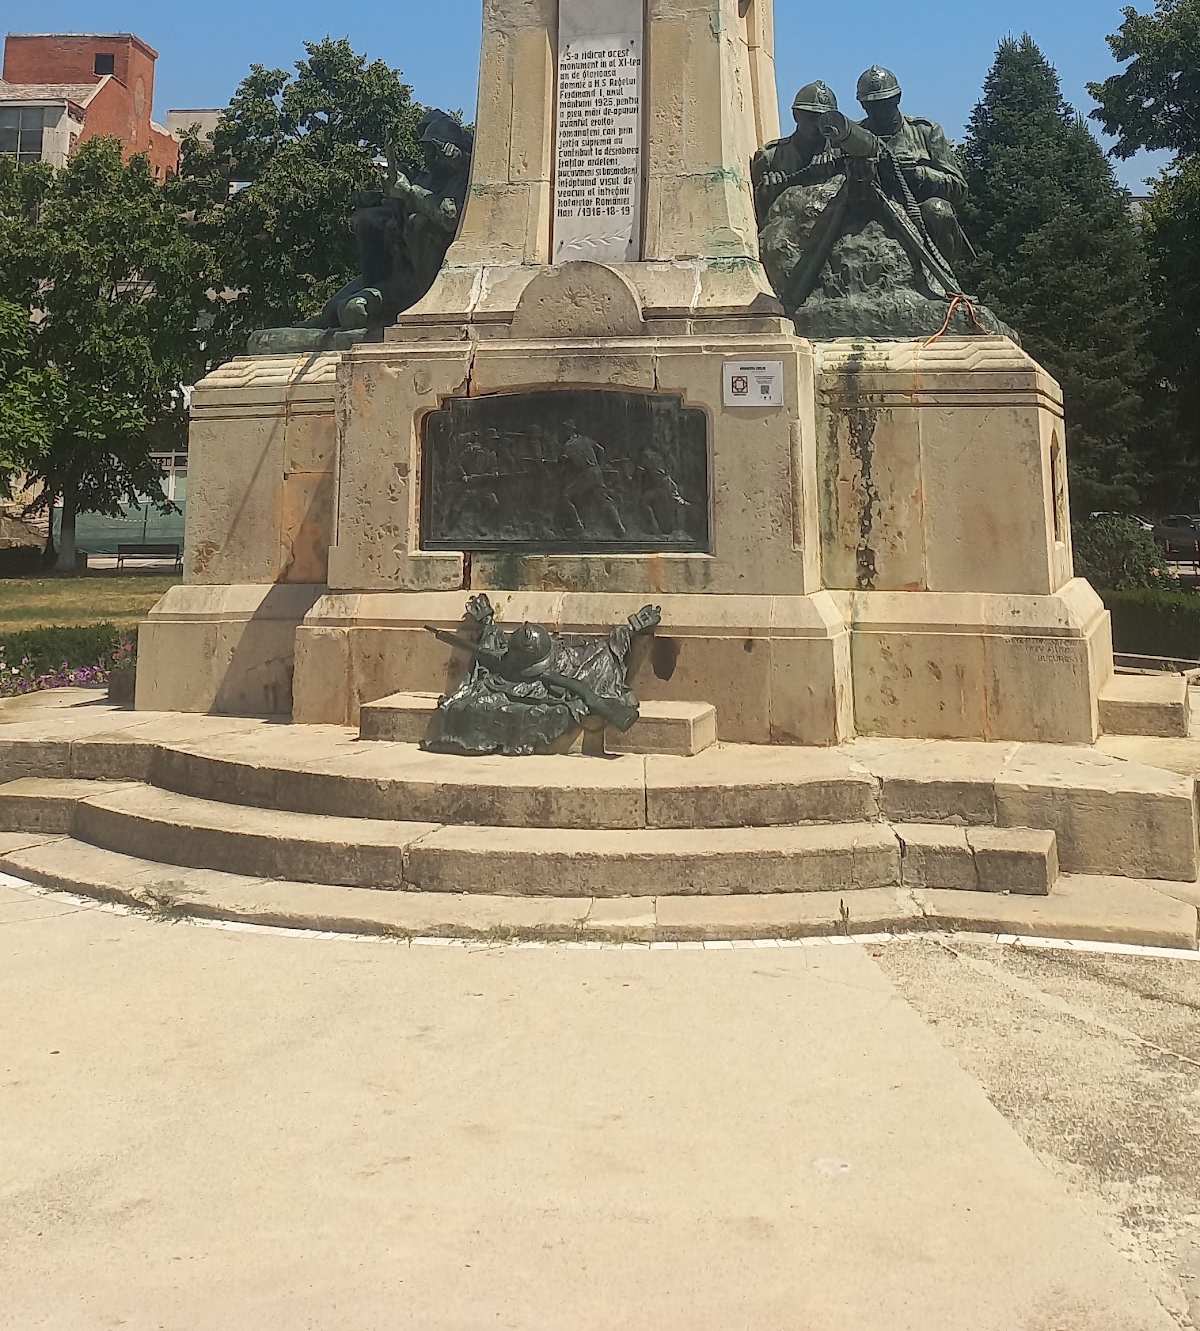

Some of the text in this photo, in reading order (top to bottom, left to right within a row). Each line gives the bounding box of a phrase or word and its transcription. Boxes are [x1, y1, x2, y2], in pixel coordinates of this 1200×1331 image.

[581, 51, 606, 60] ridicat
[607, 48, 630, 58] acest
[560, 60, 599, 70] monument
[560, 89, 596, 99] Ferdinand
[616, 97, 639, 106] pentru
[599, 176, 620, 186] visul
[623, 176, 633, 185] de
